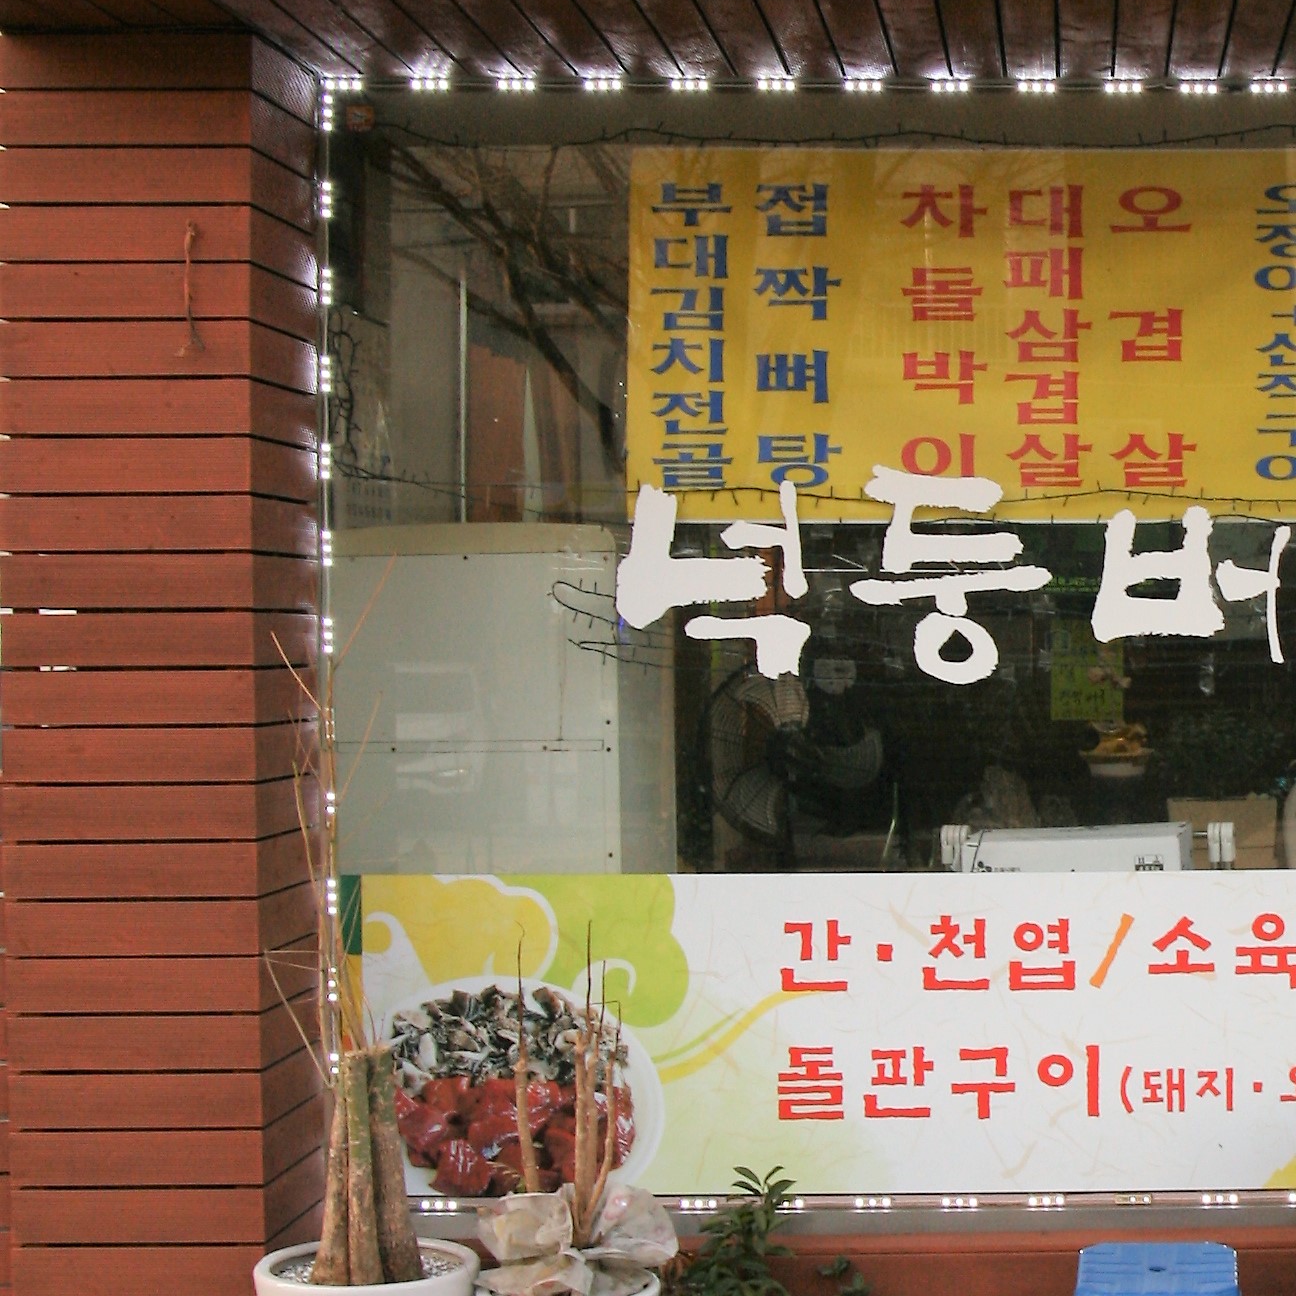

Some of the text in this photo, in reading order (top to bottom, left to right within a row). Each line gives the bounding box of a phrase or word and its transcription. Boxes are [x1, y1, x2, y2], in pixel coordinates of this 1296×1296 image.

[652, 182, 733, 489] 부대김치전골
[753, 183, 842, 487] 접짝뼈탕
[900, 184, 988, 478] 차돌박이
[1003, 184, 1093, 489] 대패삼겹살
[1109, 185, 1198, 488] 오겹살
